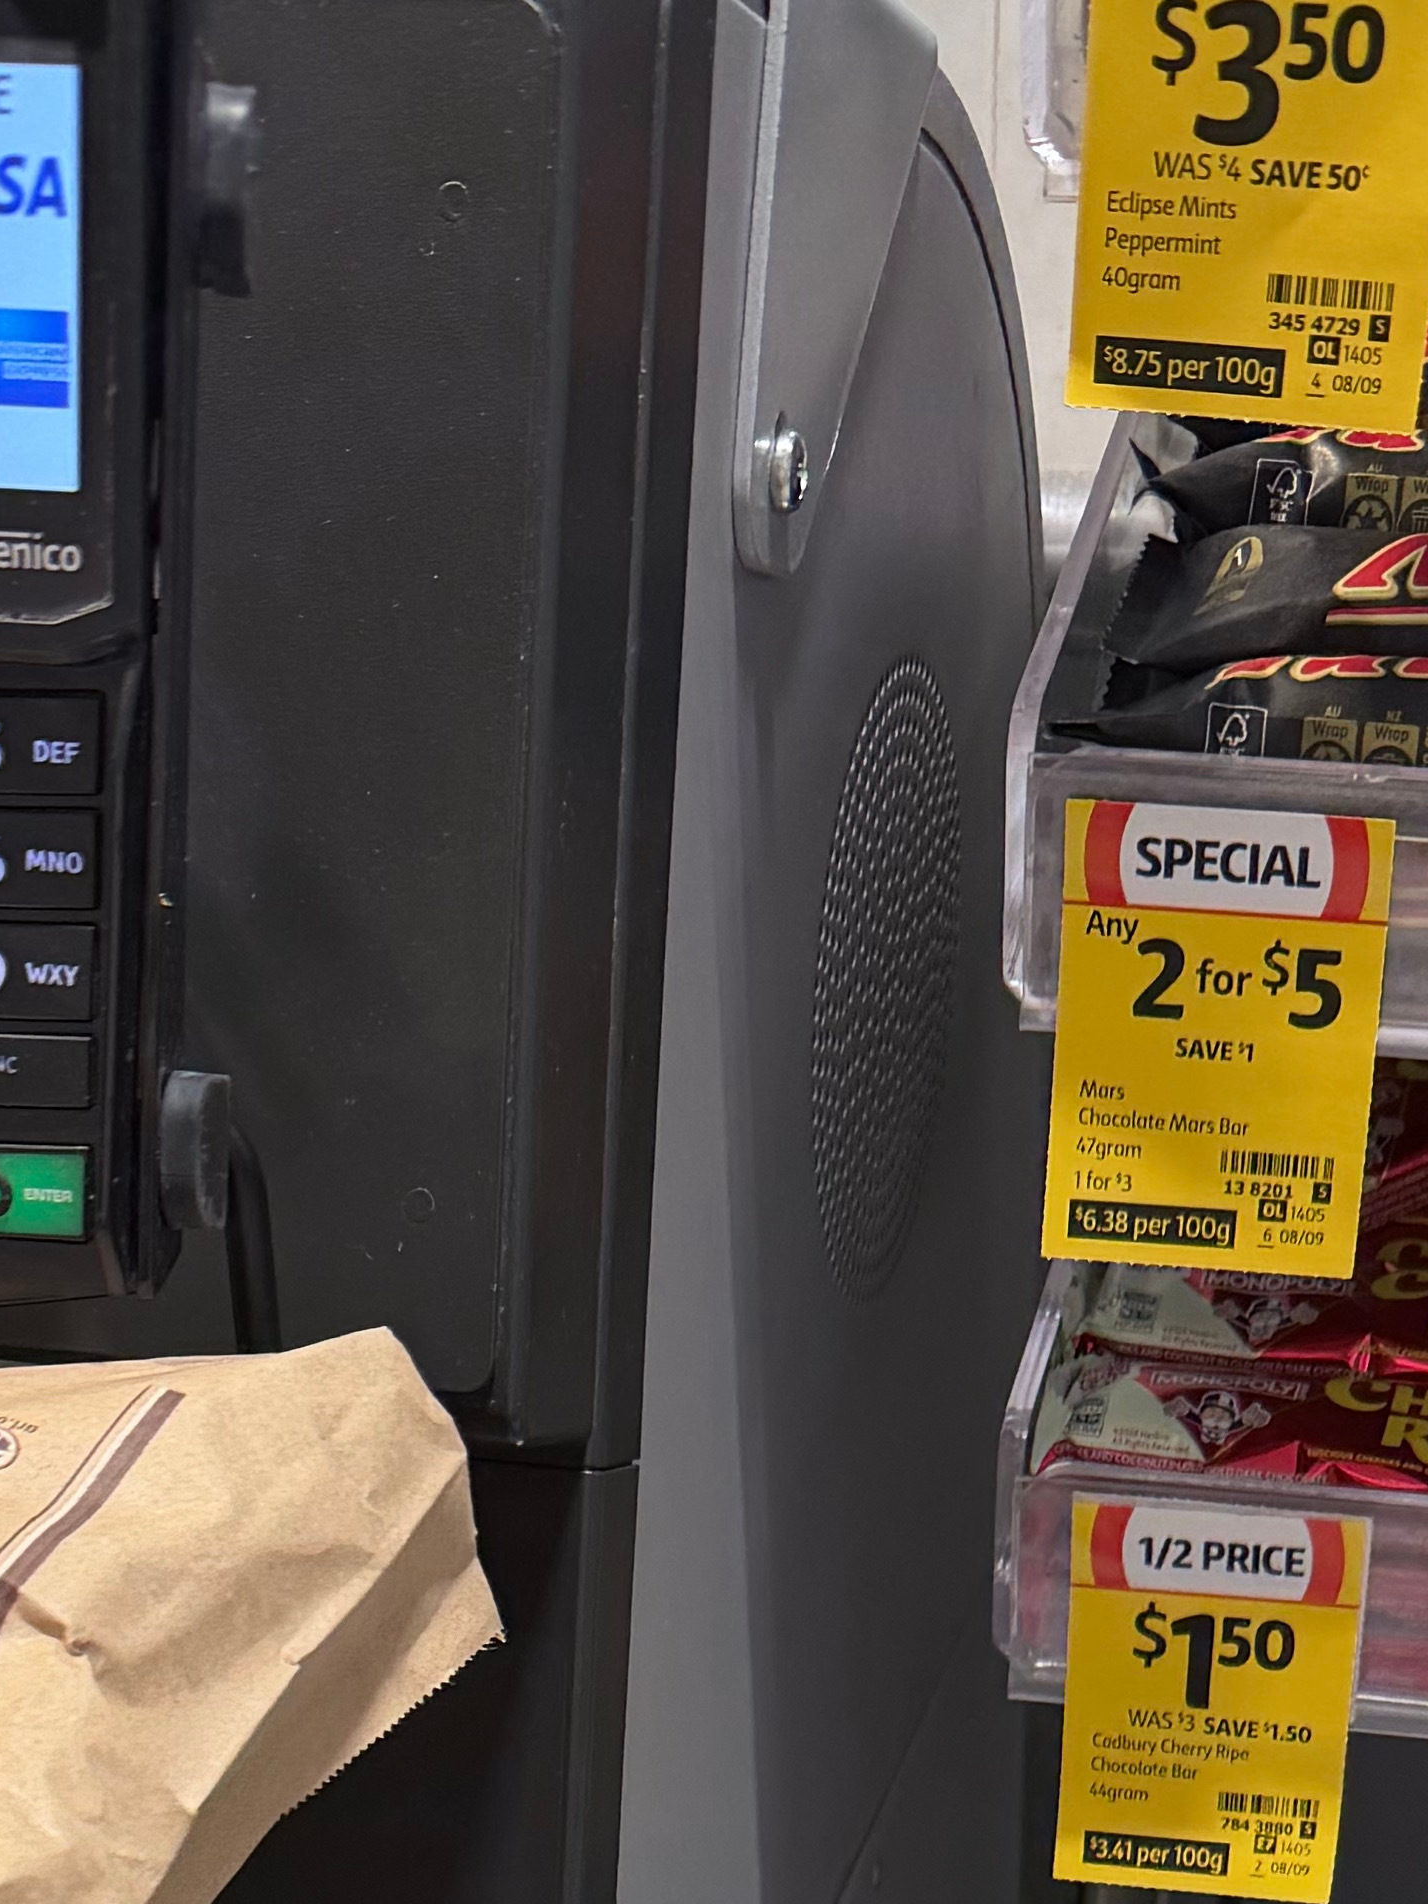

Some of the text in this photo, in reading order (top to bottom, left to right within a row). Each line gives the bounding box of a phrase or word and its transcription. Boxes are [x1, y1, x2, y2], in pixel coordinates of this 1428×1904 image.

[1154, 151, 1322, 189] WAS SAVE
[1107, 190, 1237, 221] Eclipse Mints
[1105, 227, 1222, 257] Peppermint
[1102, 266, 1181, 294] 40gram
[1268, 312, 1360, 336] 345 4729
[1344, 345, 1382, 366] 1405
[1167, 356, 1276, 394] per 100g
[1332, 375, 1382, 395] 08/09
[32, 740, 80, 764] DEF
[25, 849, 83, 874] MNO
[1135, 836, 1321, 890] SPECIAL
[1085, 908, 1139, 945] Any
[25, 961, 80, 986] WXY
[1132, 937, 1186, 1021] 2
[1195, 958, 1252, 997] for
[1175, 1037, 1233, 1062] SAVE
[1079, 1078, 1125, 1101] Mars
[1078, 1106, 1249, 1136] Chocolate Mars Bar
[1076, 1137, 1142, 1162] 47gram
[23, 1187, 73, 1203] ENTER
[1139, 1537, 1306, 1578] 1/2 PRICE
[1092, 1732, 1212, 1759] Cadbury Cherry
